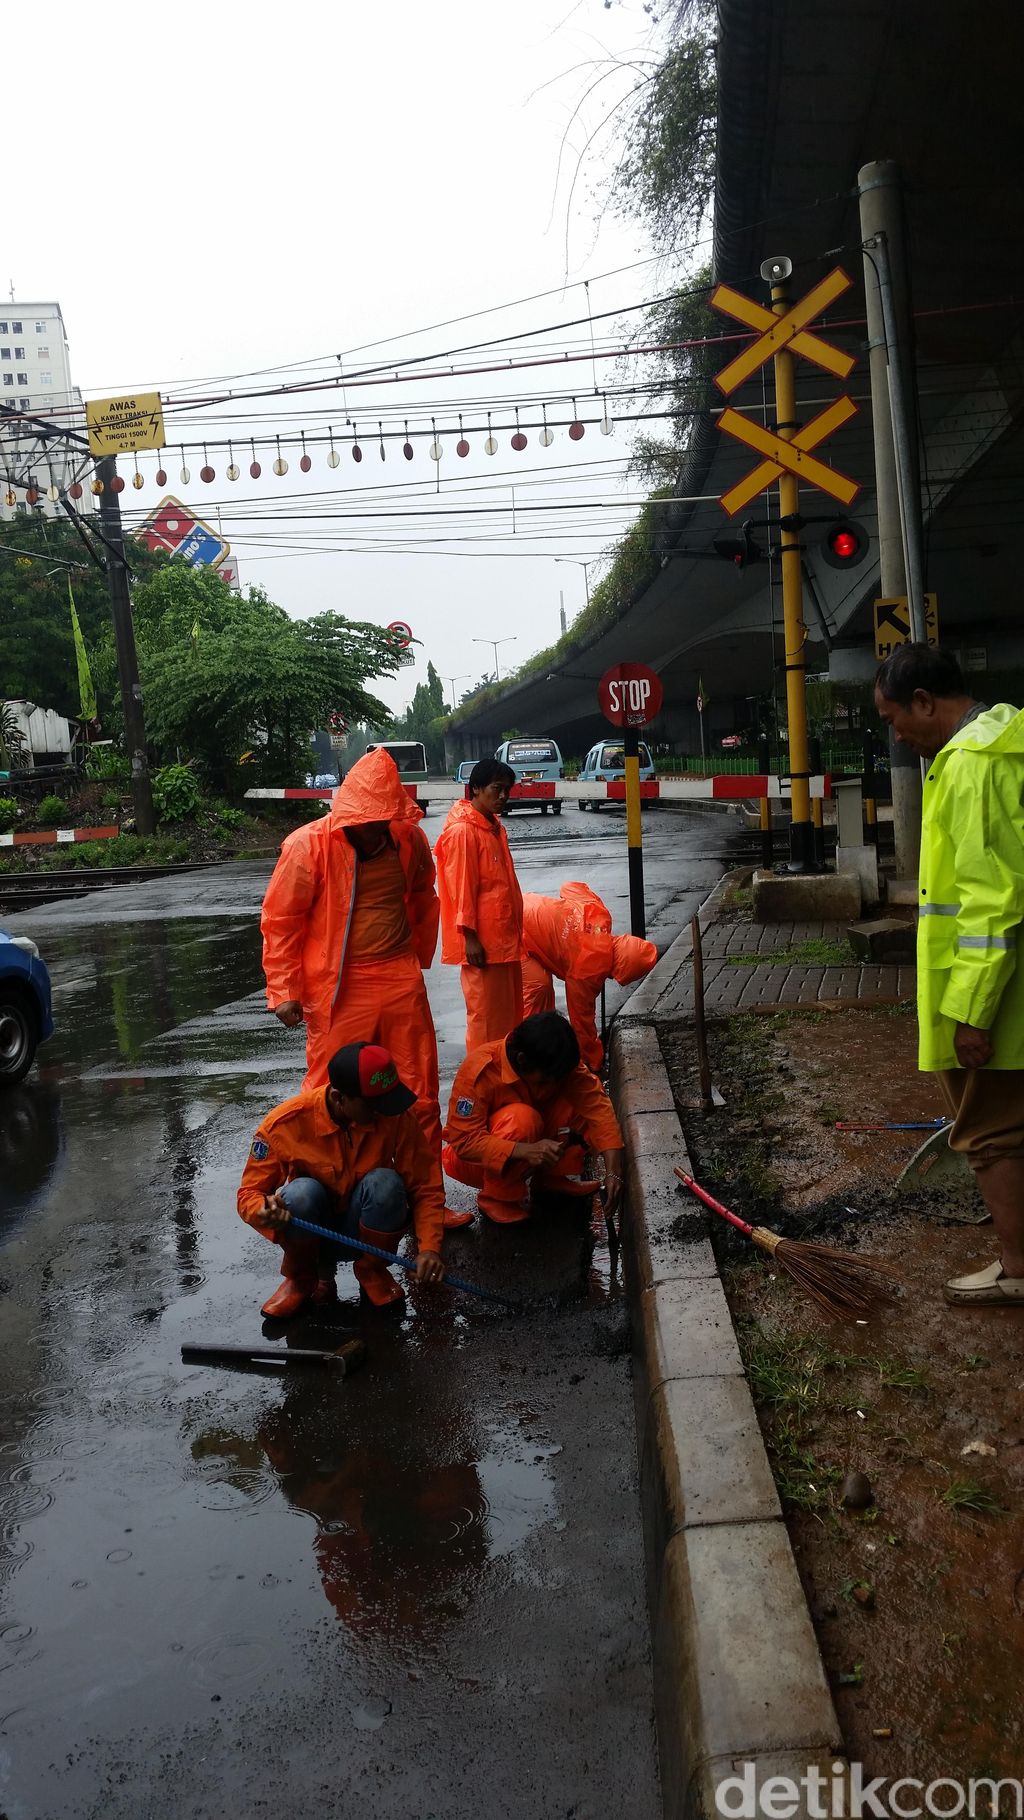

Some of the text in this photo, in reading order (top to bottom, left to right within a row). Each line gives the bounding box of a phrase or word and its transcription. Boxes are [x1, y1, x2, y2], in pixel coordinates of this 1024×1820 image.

[109, 400, 136, 412] AWAS
[101, 410, 148, 422] KAWAT TRAKSI
[108, 421, 143, 431] TEGANGAN
[105, 430, 148, 441] TINGGI 1500V
[608, 679, 651, 712] STOP
